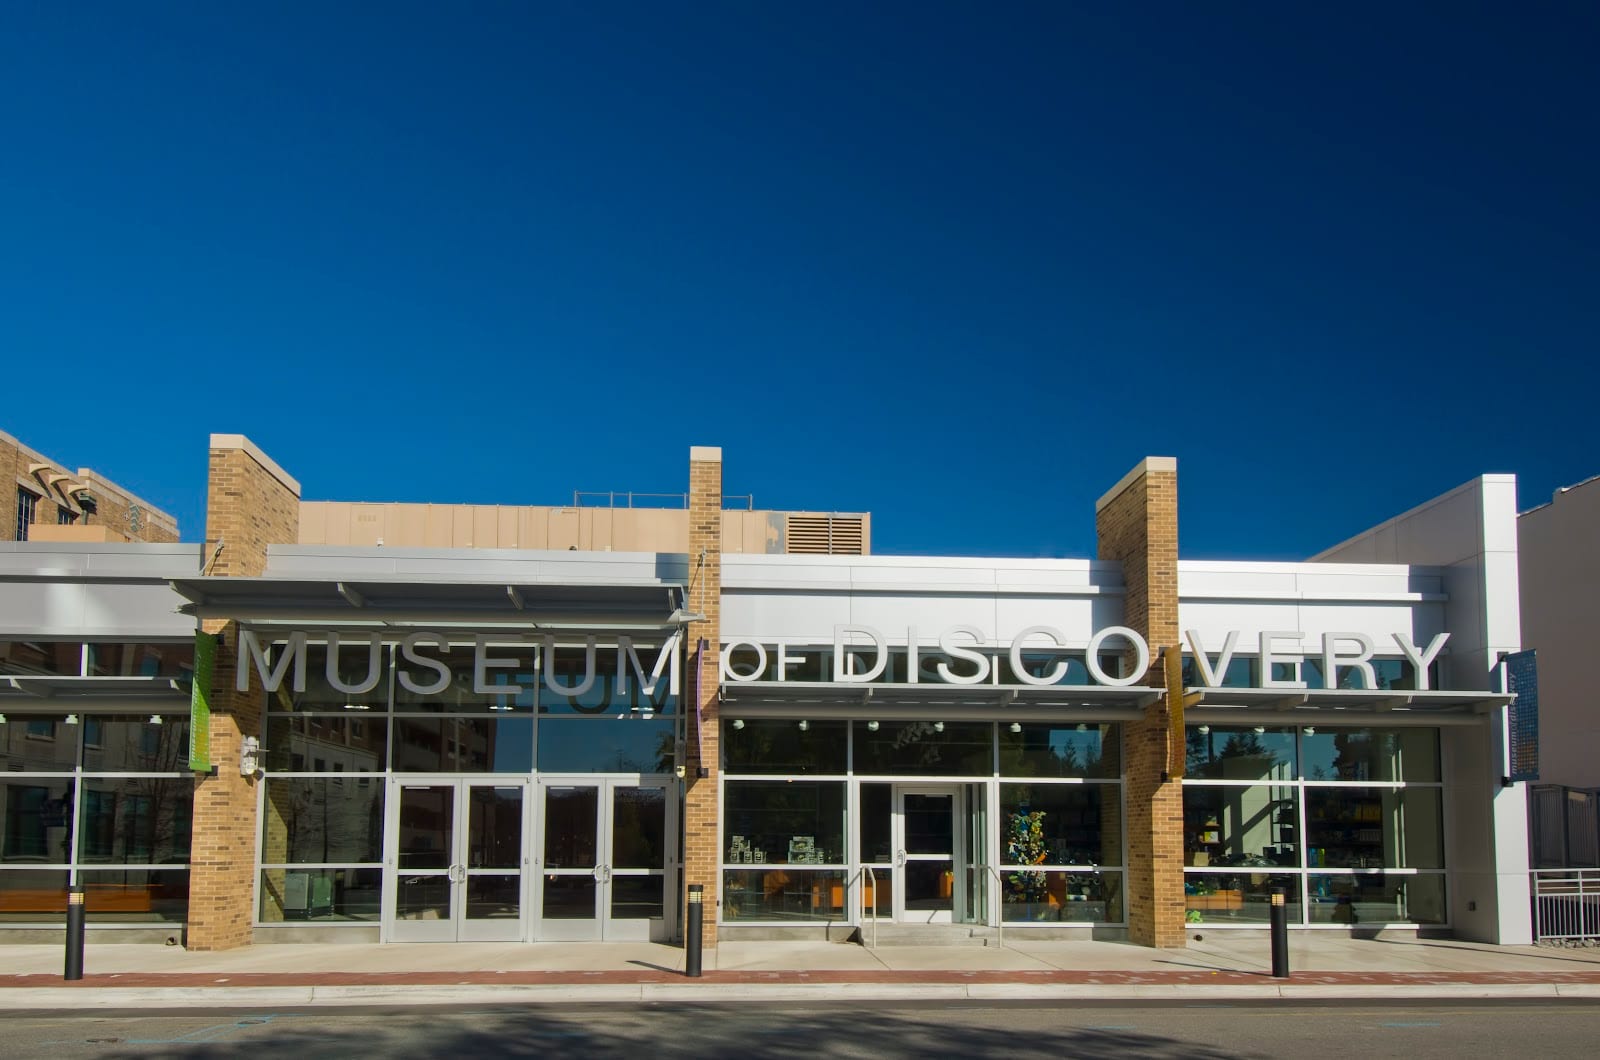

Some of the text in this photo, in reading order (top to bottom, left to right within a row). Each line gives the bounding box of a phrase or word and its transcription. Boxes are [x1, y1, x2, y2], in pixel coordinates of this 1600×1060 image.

[236, 624, 681, 696] MUSEUM
[722, 640, 808, 682] OF
[833, 624, 1451, 690] DISCOVERY
